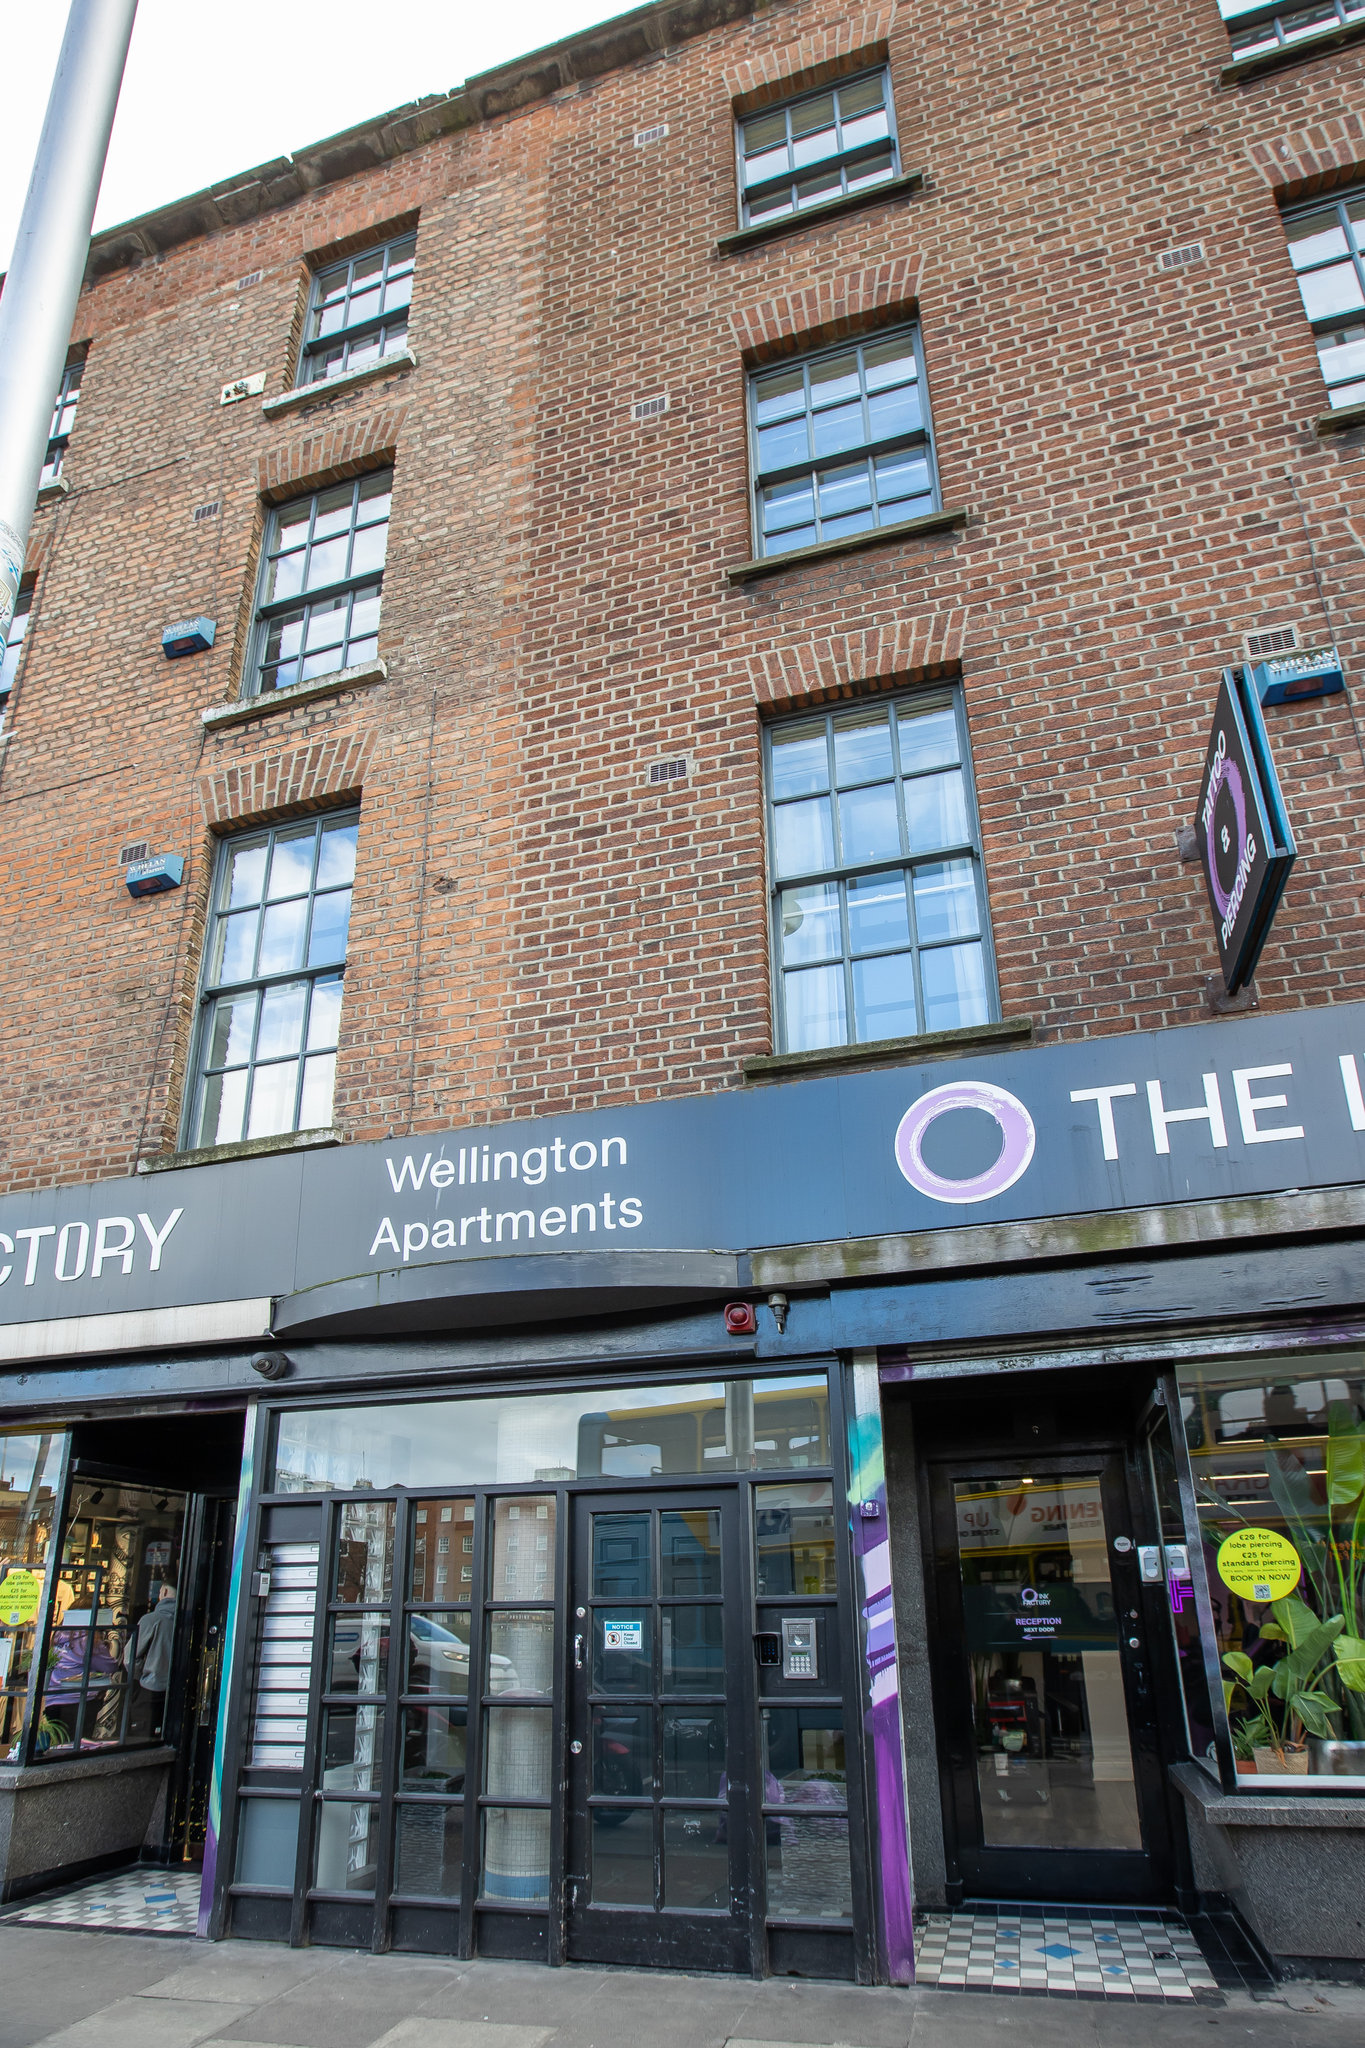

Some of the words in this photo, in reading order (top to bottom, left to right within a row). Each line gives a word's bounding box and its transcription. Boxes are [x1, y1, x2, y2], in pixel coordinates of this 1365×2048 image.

[1268, 650, 1335, 673] WHELAN
[1297, 661, 1338, 674] alarms
[1202, 730, 1226, 832] TATTOO
[130, 857, 166, 873] WHELAN
[1221, 833, 1257, 950] PIERCING
[1069, 1062, 1305, 1161] THE
[385, 1136, 628, 1193] Wellington
[368, 1192, 643, 1262] Apartments
[1249, 1540, 1283, 1549] piercing
[1262, 1558, 1297, 1567] piercing
[1268, 1573, 1291, 1581] NOW
[1015, 1617, 1062, 1626] RECEPTION
